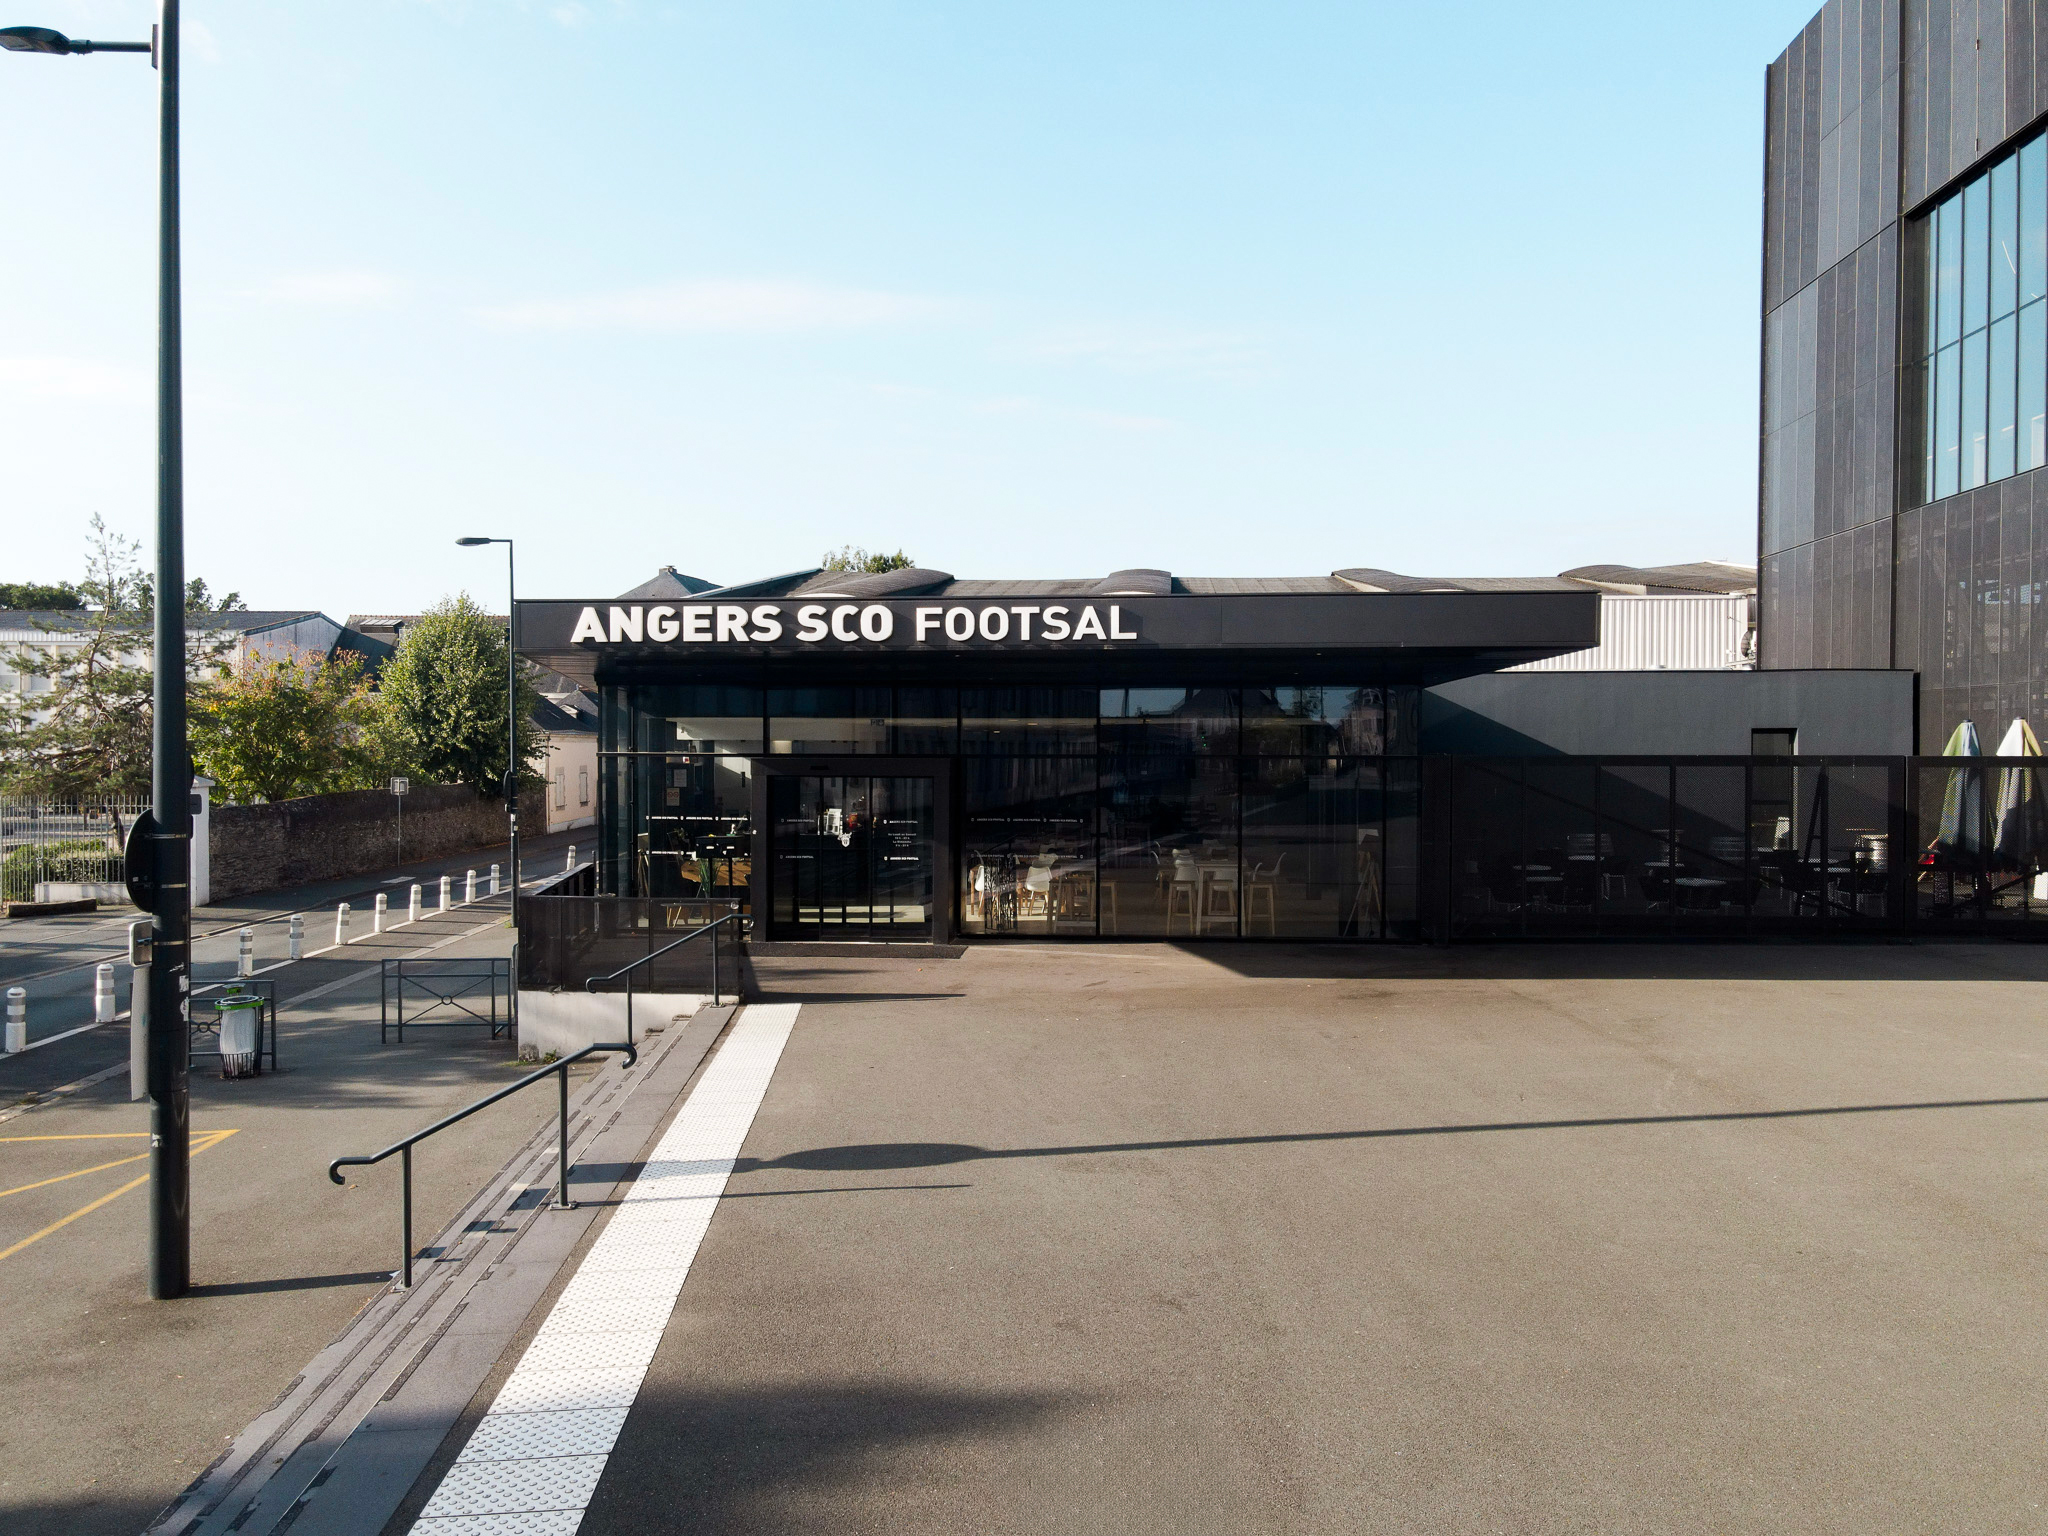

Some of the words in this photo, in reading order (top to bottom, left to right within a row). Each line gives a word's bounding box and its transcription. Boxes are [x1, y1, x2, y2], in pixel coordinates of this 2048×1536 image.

[570, 605, 783, 643] ANGERS
[795, 605, 894, 642] SCO
[916, 605, 1138, 641] FOOTSAL
